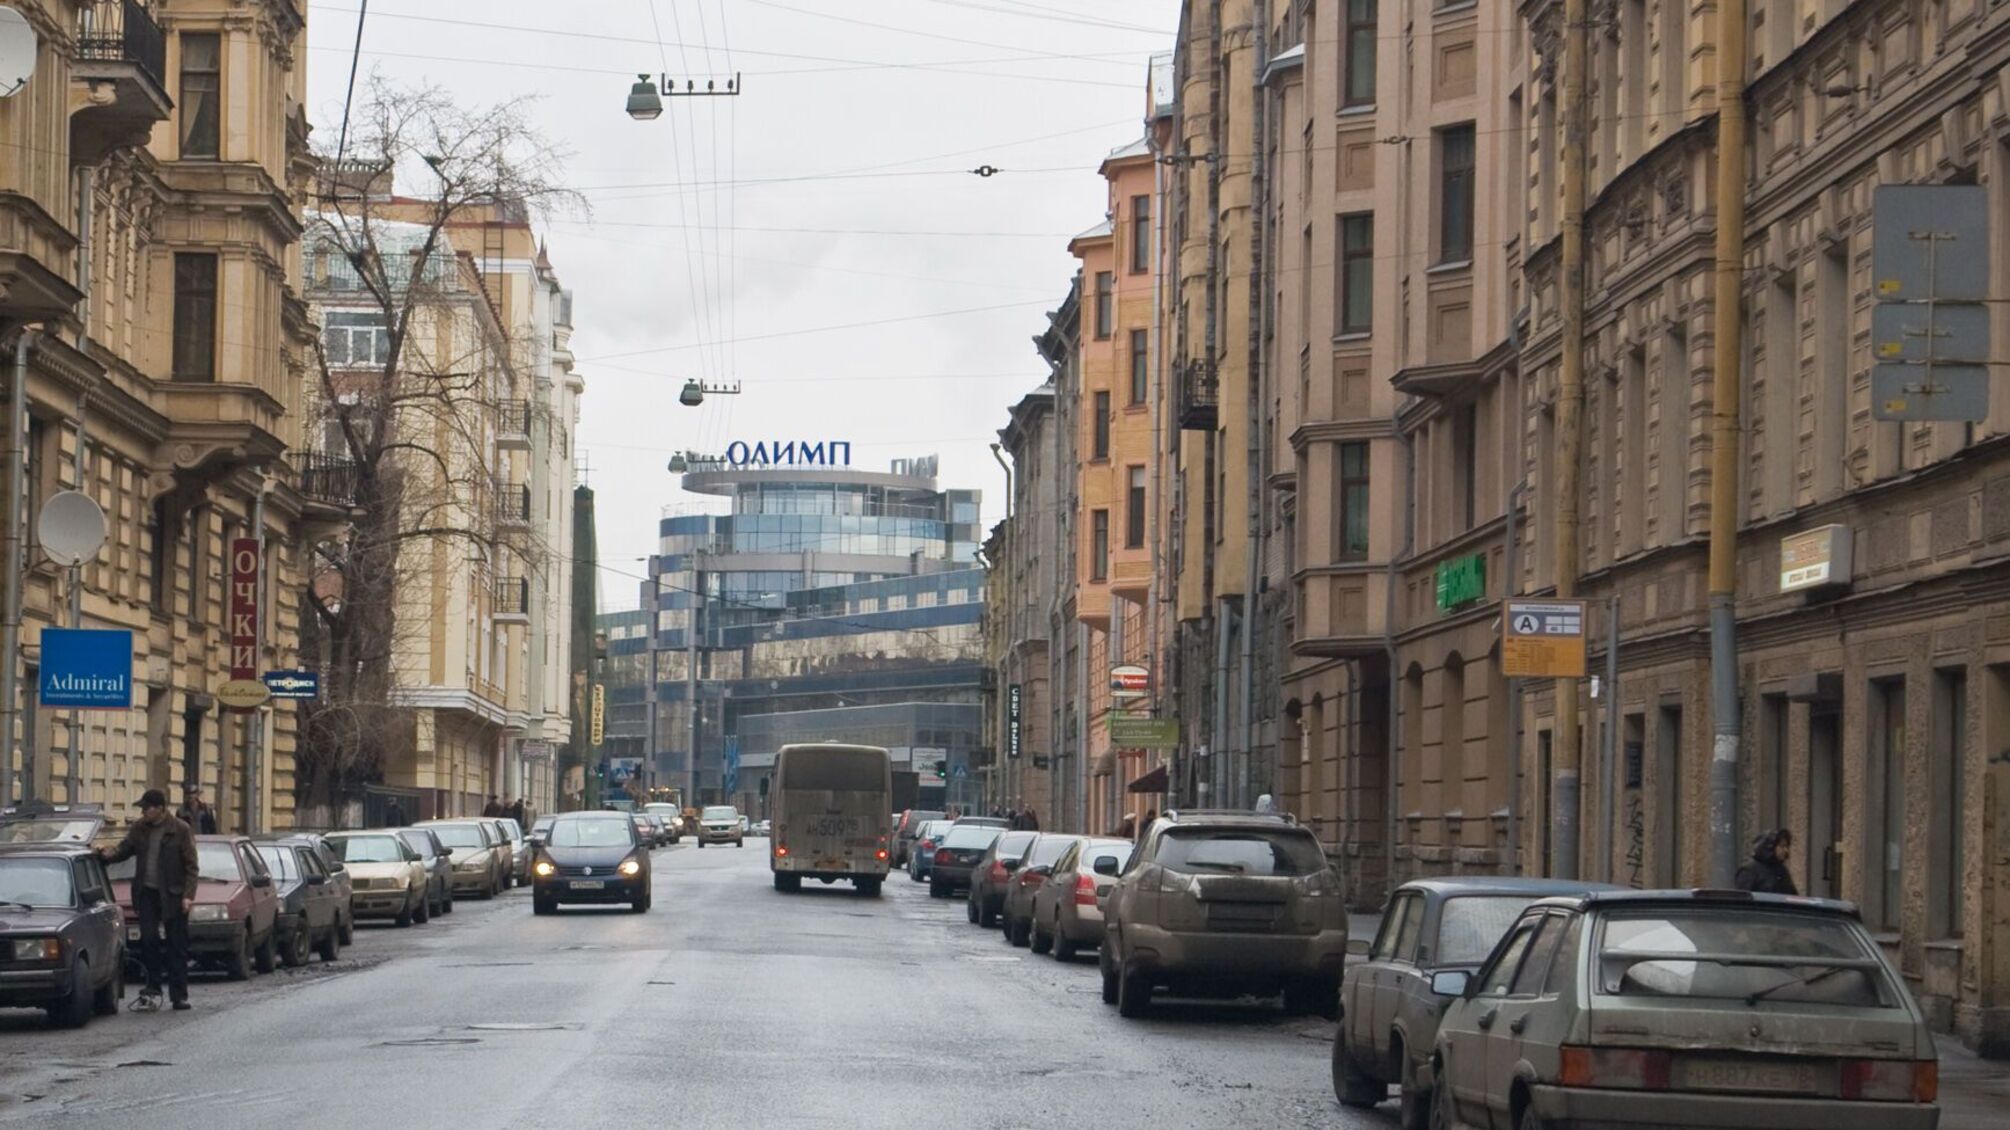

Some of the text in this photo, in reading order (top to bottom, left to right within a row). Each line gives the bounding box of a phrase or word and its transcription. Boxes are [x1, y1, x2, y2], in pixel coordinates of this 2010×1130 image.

[726, 440, 851, 466] ОЛИМП
[233, 550, 256, 669] ОЧКИ
[46, 672, 124, 692] Admiral
